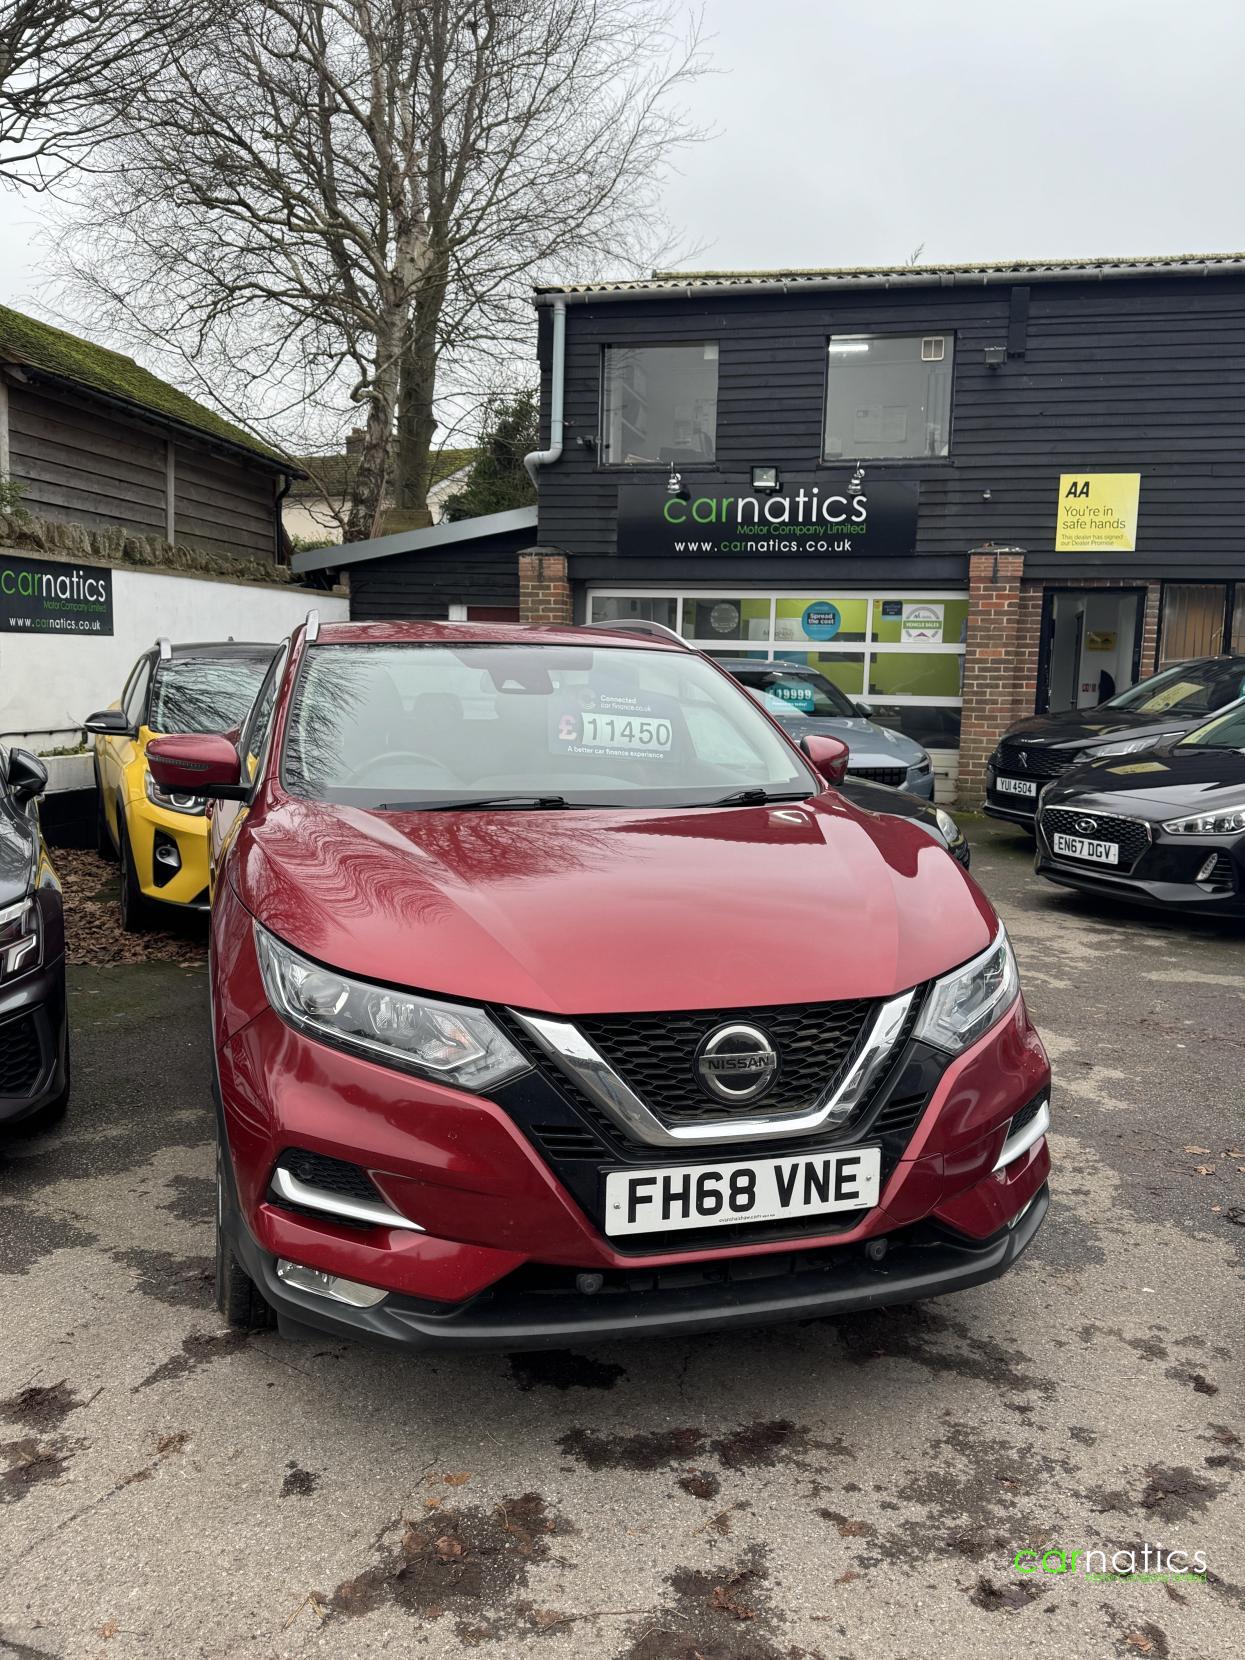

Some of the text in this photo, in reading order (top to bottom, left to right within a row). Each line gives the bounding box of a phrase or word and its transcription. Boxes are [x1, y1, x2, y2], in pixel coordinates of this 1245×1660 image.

[1065, 481, 1090, 498] AA
[663, 487, 868, 523] carnatics
[1064, 506, 1114, 517] You're in
[737, 523, 867, 536] Motor Company Limited
[1062, 518, 1126, 530] safe hands
[674, 539, 852, 551] www.carnatics.co.uk
[1, 570, 106, 602] carnatics
[9, 616, 101, 631] www.carnatics.co.uk
[600, 694, 637, 704] Connected
[574, 746, 592, 754] better
[606, 748, 629, 757] finance
[630, 750, 664, 759] experience
[1058, 837, 1112, 860] EN67 DGV
[708, 1055, 769, 1070] NISSAN
[627, 1156, 861, 1224] FH68 VNE
